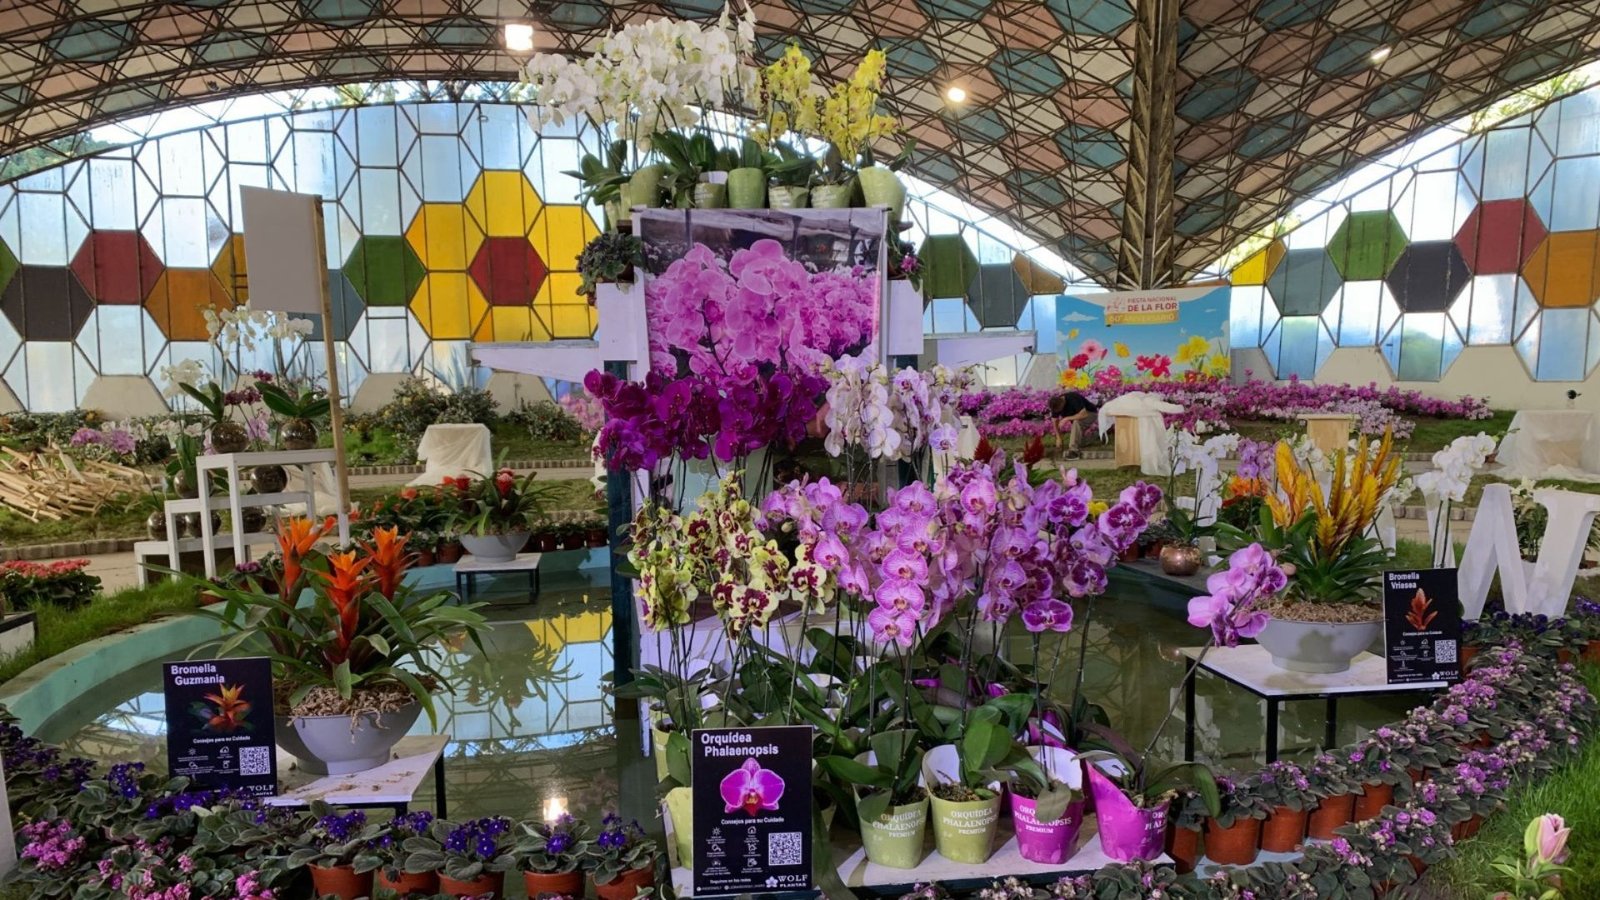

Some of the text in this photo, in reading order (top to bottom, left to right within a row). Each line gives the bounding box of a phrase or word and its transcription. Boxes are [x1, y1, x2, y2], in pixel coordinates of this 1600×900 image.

[1127, 302, 1177, 312] DE LA FLOR
[1389, 572, 1420, 581] Bromelia
[170, 663, 217, 675] Bromelia
[174, 674, 225, 686] Guzmania
[701, 732, 752, 746] Orquídea
[704, 743, 779, 758] Phalaenopsis
[958, 826, 986, 835] PREMIUM
[1025, 824, 1054, 834] PREMIUM
[777, 874, 808, 882] WOLF
